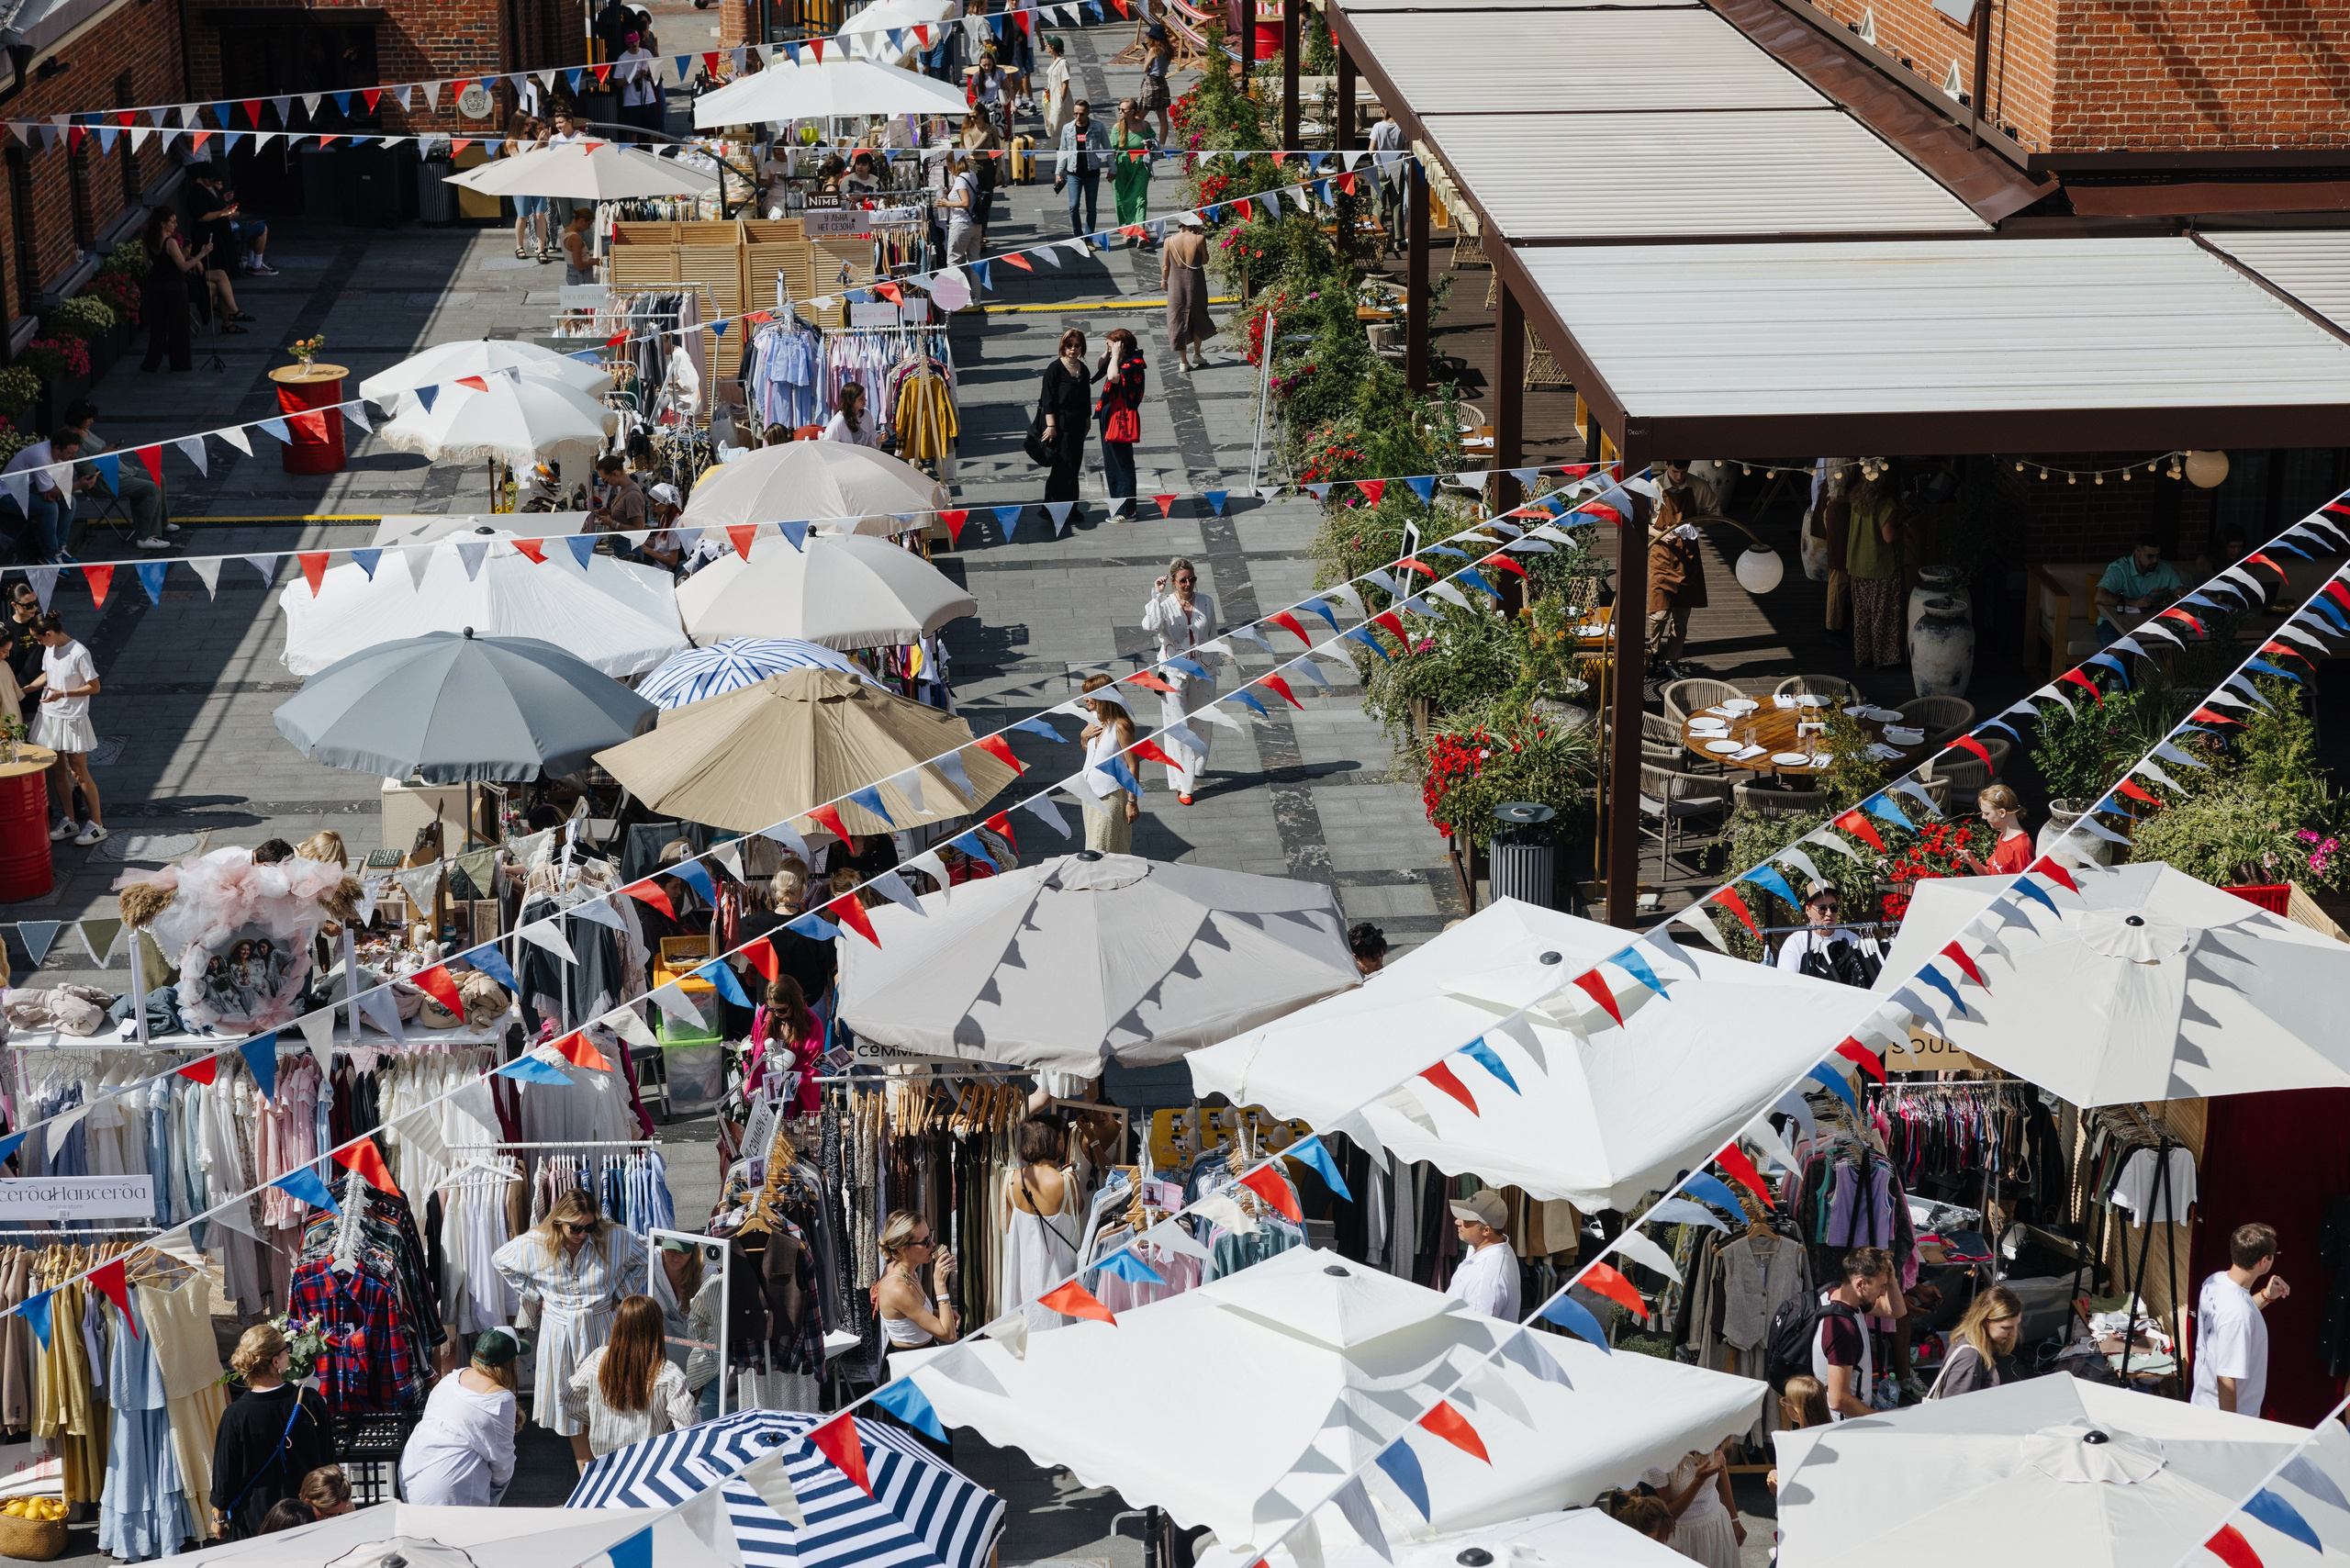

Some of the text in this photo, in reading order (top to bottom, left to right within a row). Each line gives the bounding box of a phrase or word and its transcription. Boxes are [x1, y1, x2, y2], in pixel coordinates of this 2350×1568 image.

[823, 213, 848, 222] У ЛЬНА
[817, 222, 856, 231] НЕТ СЕЗОНА
